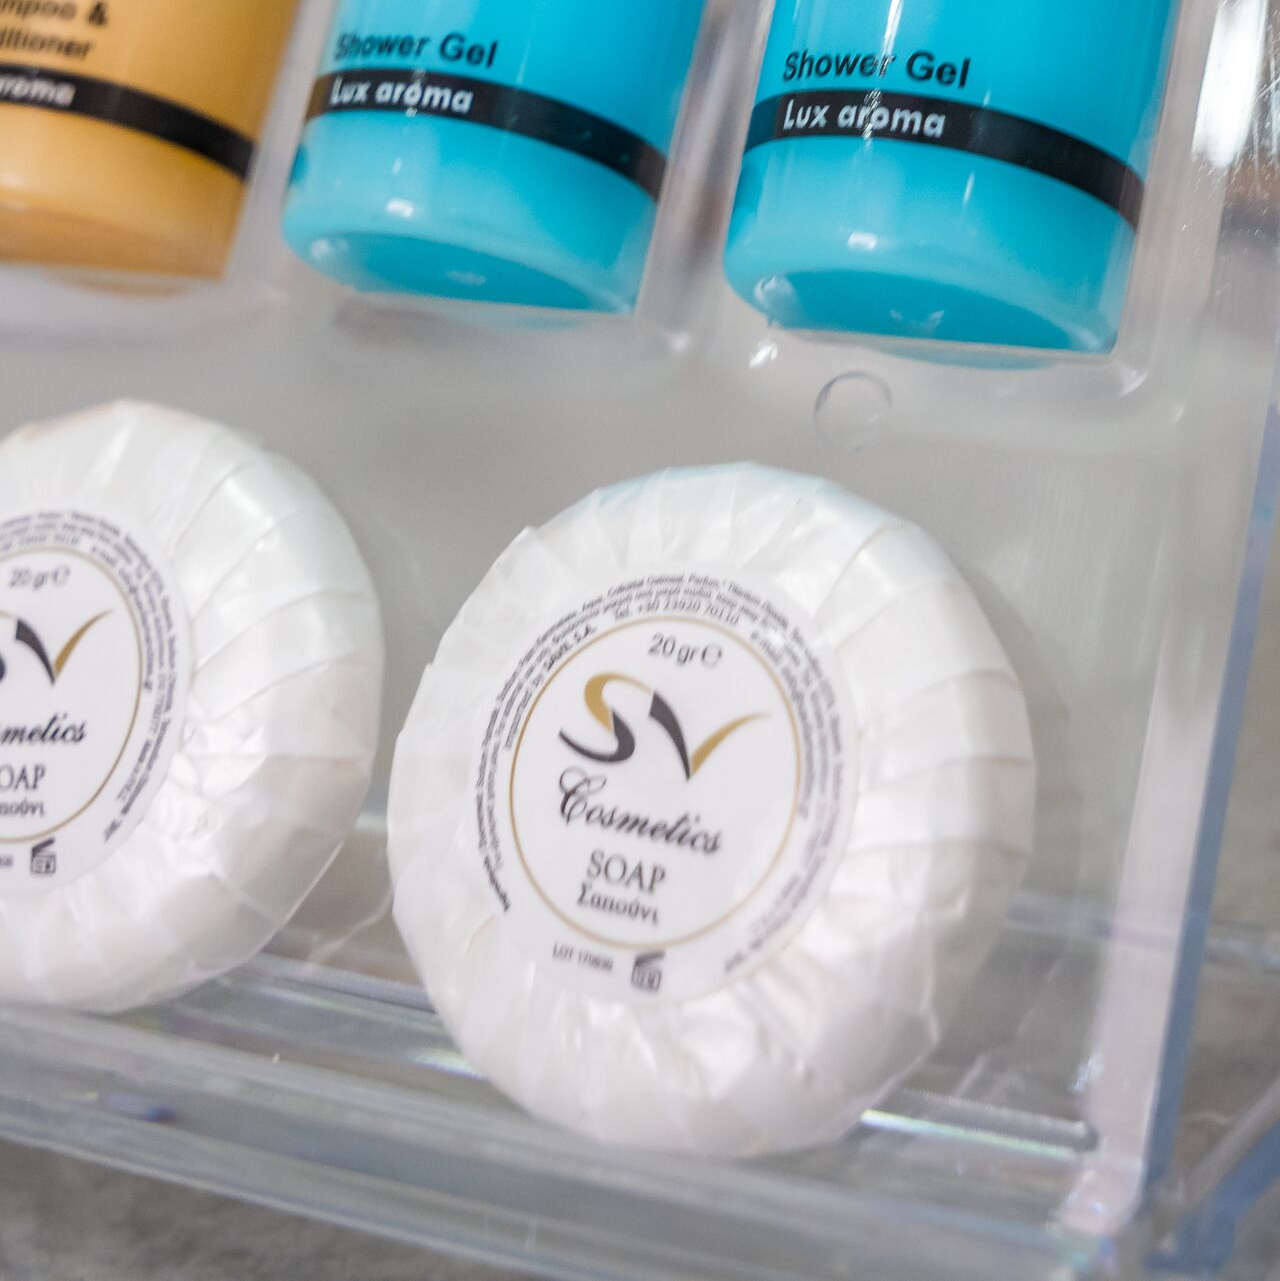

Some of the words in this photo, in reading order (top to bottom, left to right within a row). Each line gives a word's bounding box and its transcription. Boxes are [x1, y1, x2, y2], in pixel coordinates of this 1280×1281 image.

[87, 0, 108, 26] &
[335, 32, 429, 61] Shower
[439, 32, 500, 69] Gel
[782, 49, 894, 82] Shower
[906, 50, 972, 88] Gel
[330, 76, 370, 105] Lux
[374, 80, 475, 115] aroma
[782, 99, 828, 131] Lux
[837, 103, 947, 138] aroma
[558, 671, 772, 782] SV
[558, 767, 722, 856] Cosmetics
[587, 848, 665, 893] SOAP
